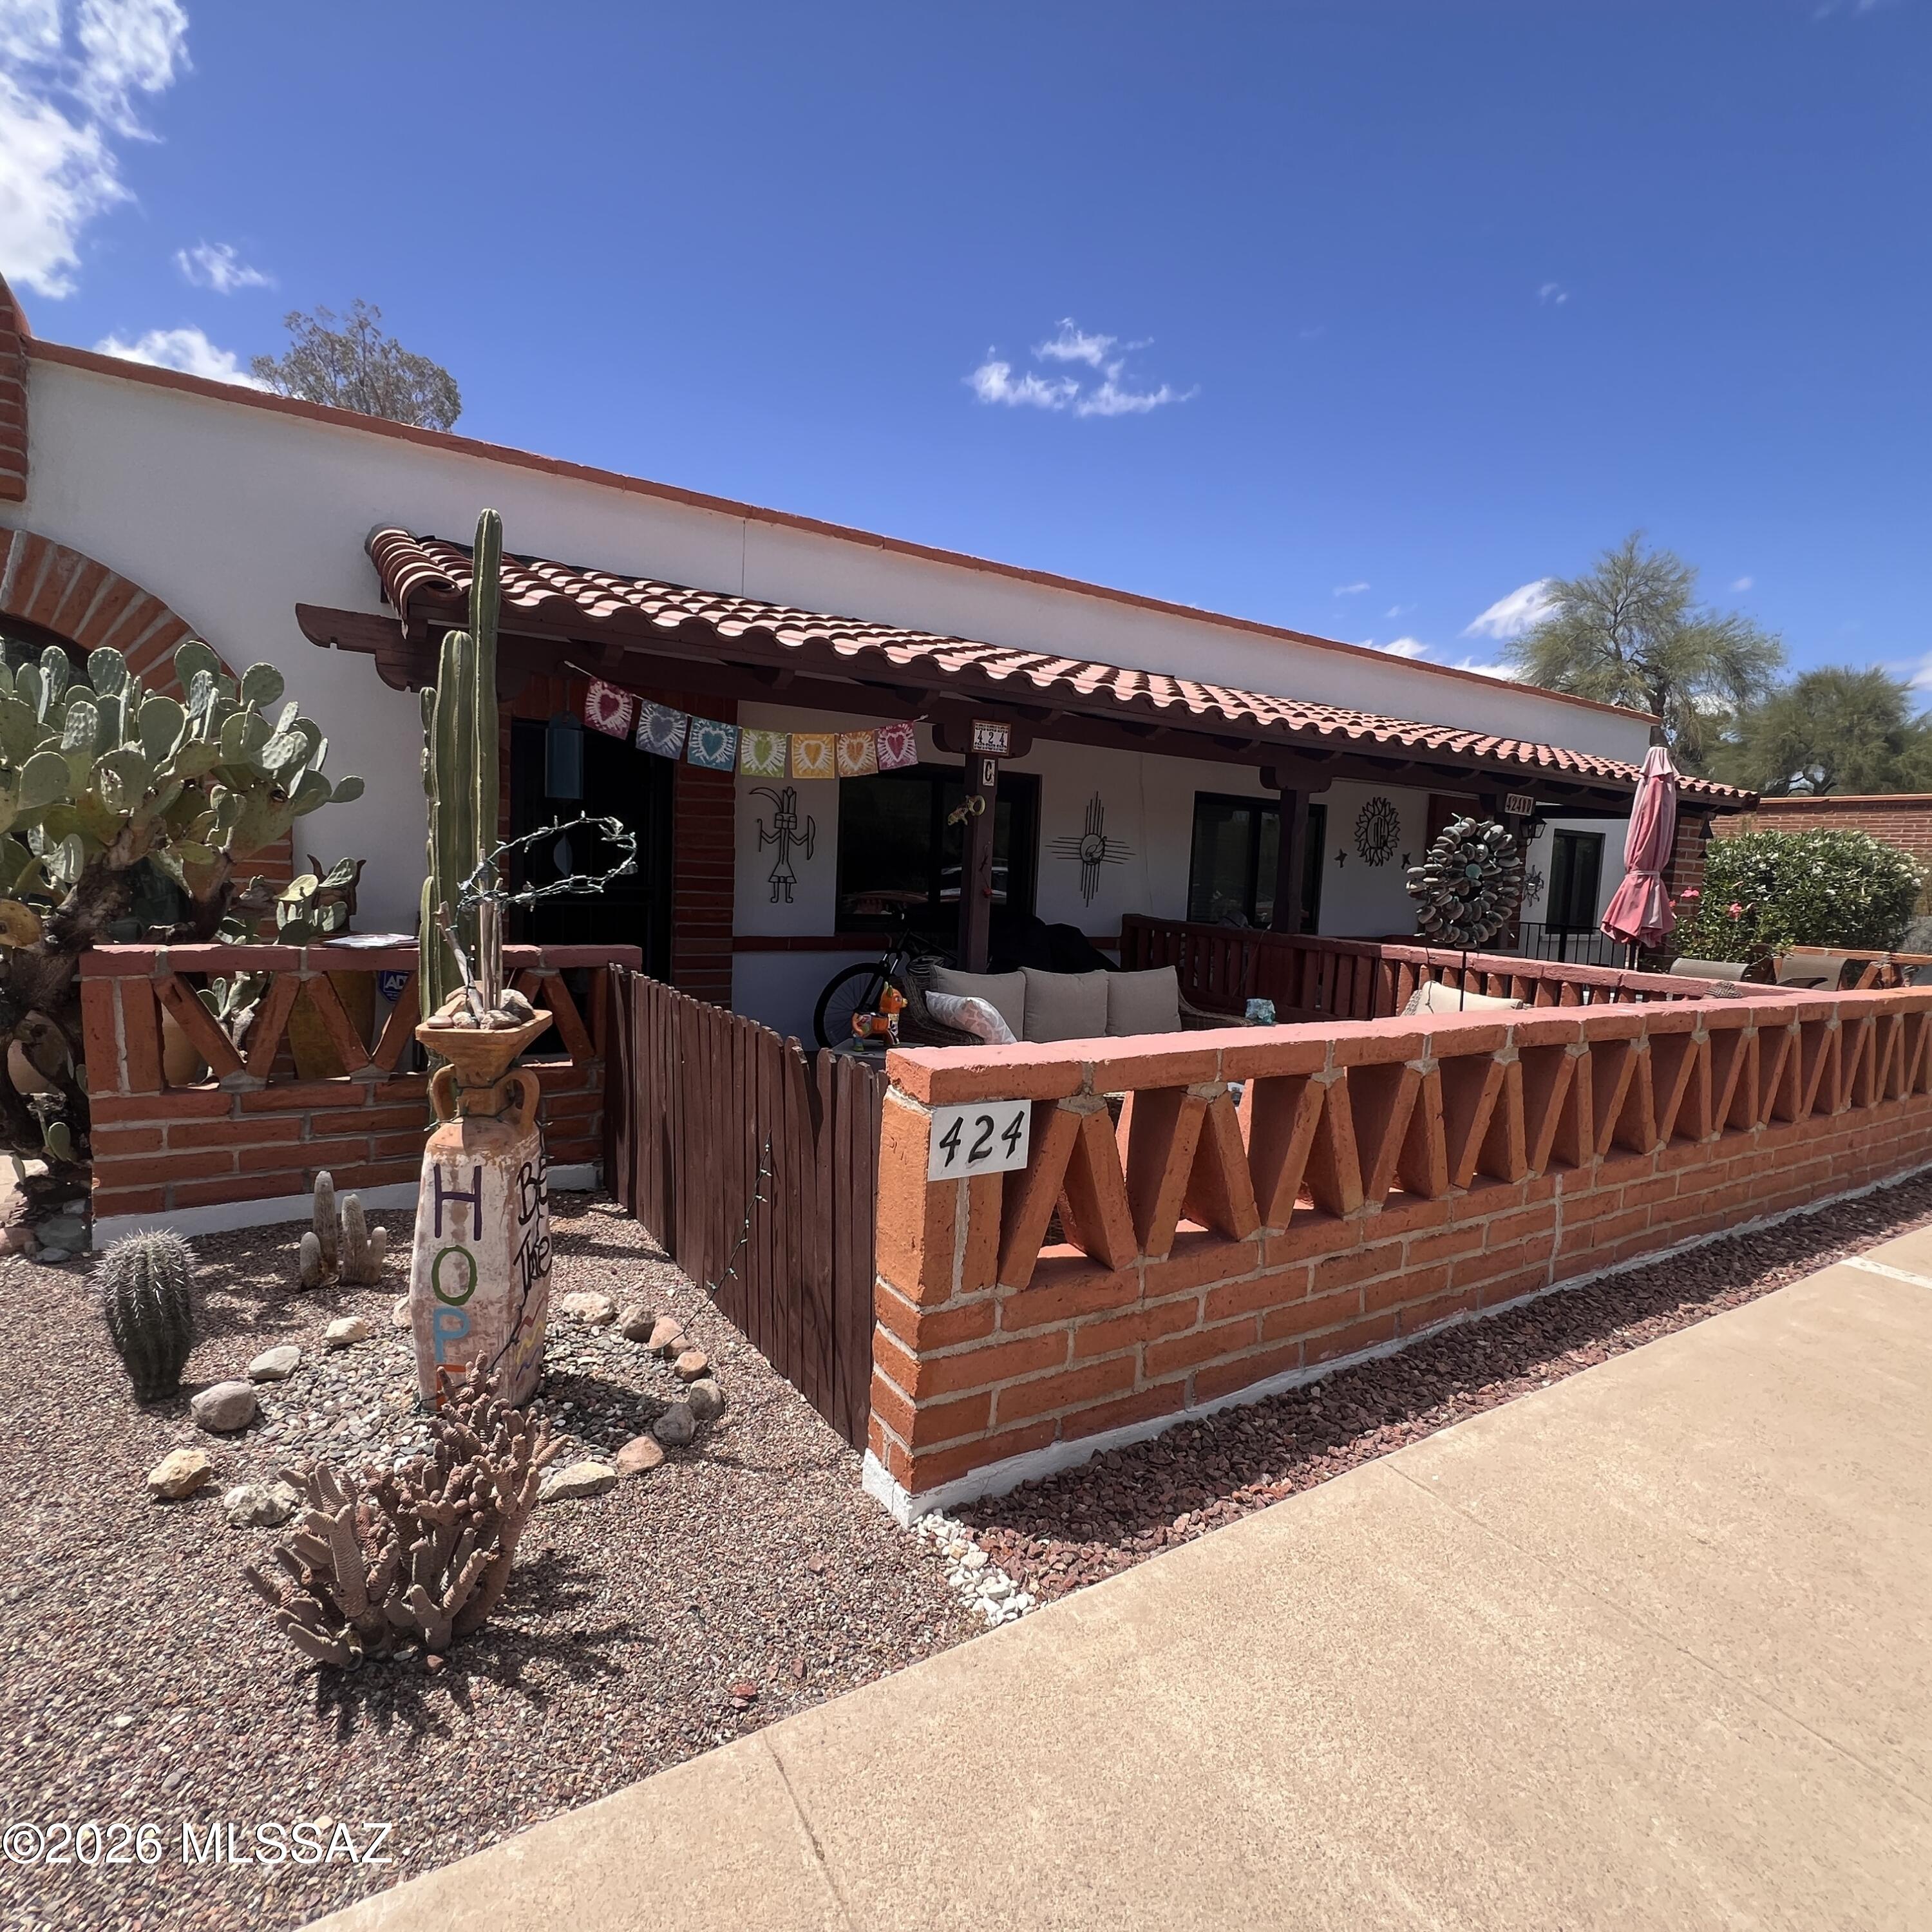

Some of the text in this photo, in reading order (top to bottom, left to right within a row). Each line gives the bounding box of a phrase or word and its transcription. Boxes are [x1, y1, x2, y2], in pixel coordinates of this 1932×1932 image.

[978, 730, 1005, 746] 424
[985, 761, 992, 781] C
[385, 975, 408, 989] AD
[939, 1110, 1025, 1168] 424
